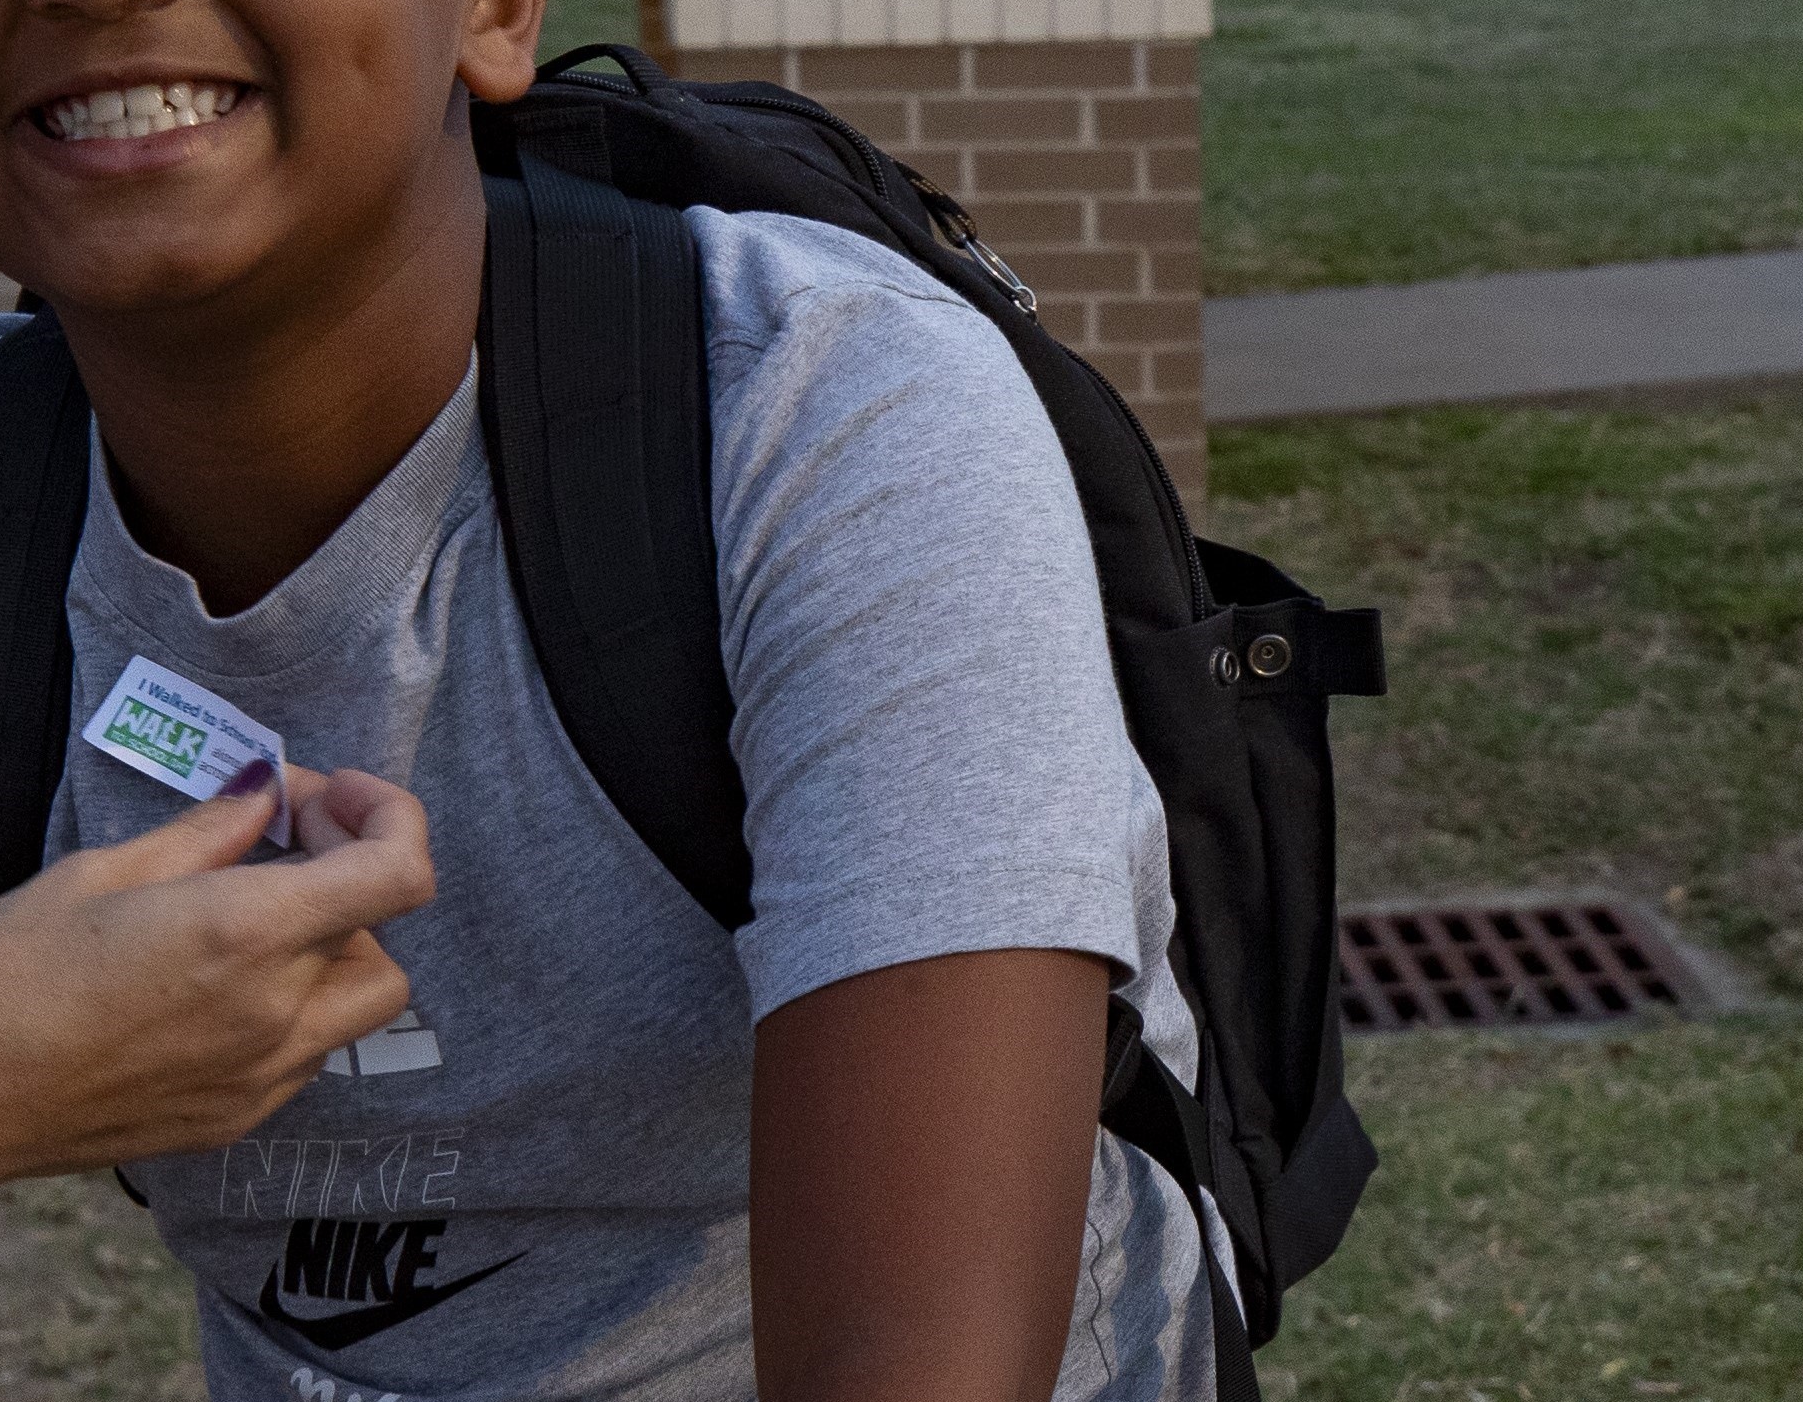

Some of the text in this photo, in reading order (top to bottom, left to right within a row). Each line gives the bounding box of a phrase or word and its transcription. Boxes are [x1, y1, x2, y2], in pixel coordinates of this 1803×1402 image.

[112, 698, 207, 763] WALK
[137, 678, 147, 691] I
[148, 682, 202, 718] Walked
[202, 710, 217, 727] to
[218, 718, 260, 750] School
[220, 1127, 465, 1220] NIKE
[282, 1217, 448, 1304] NIKE
